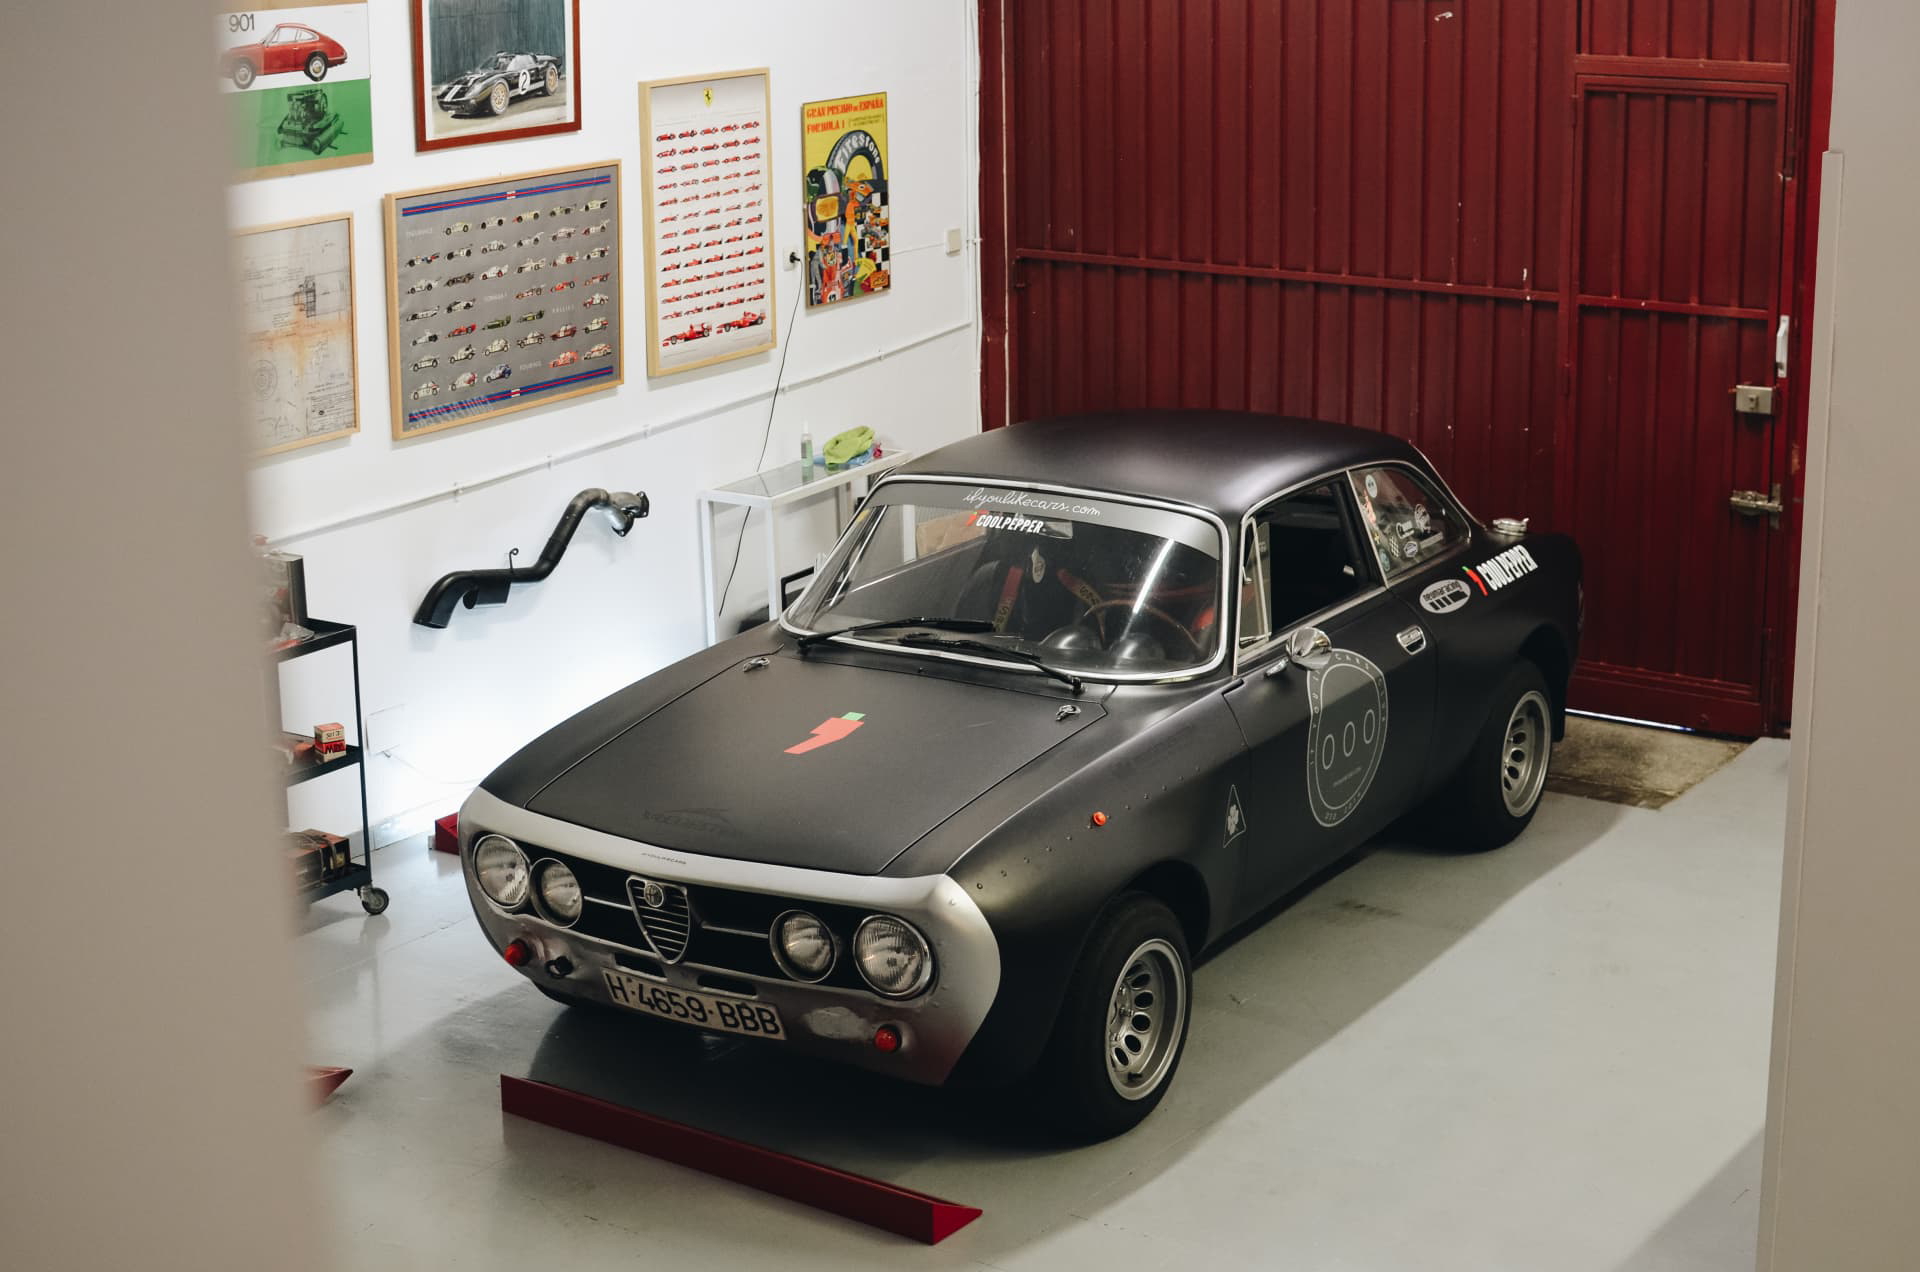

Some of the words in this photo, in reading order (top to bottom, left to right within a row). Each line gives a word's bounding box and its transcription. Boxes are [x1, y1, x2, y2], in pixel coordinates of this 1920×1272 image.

[229, 13, 255, 33] 901
[834, 133, 880, 174] Firestone
[976, 514, 1044, 534] COOLPEPPER
[1476, 544, 1538, 591] COOLPEPPER
